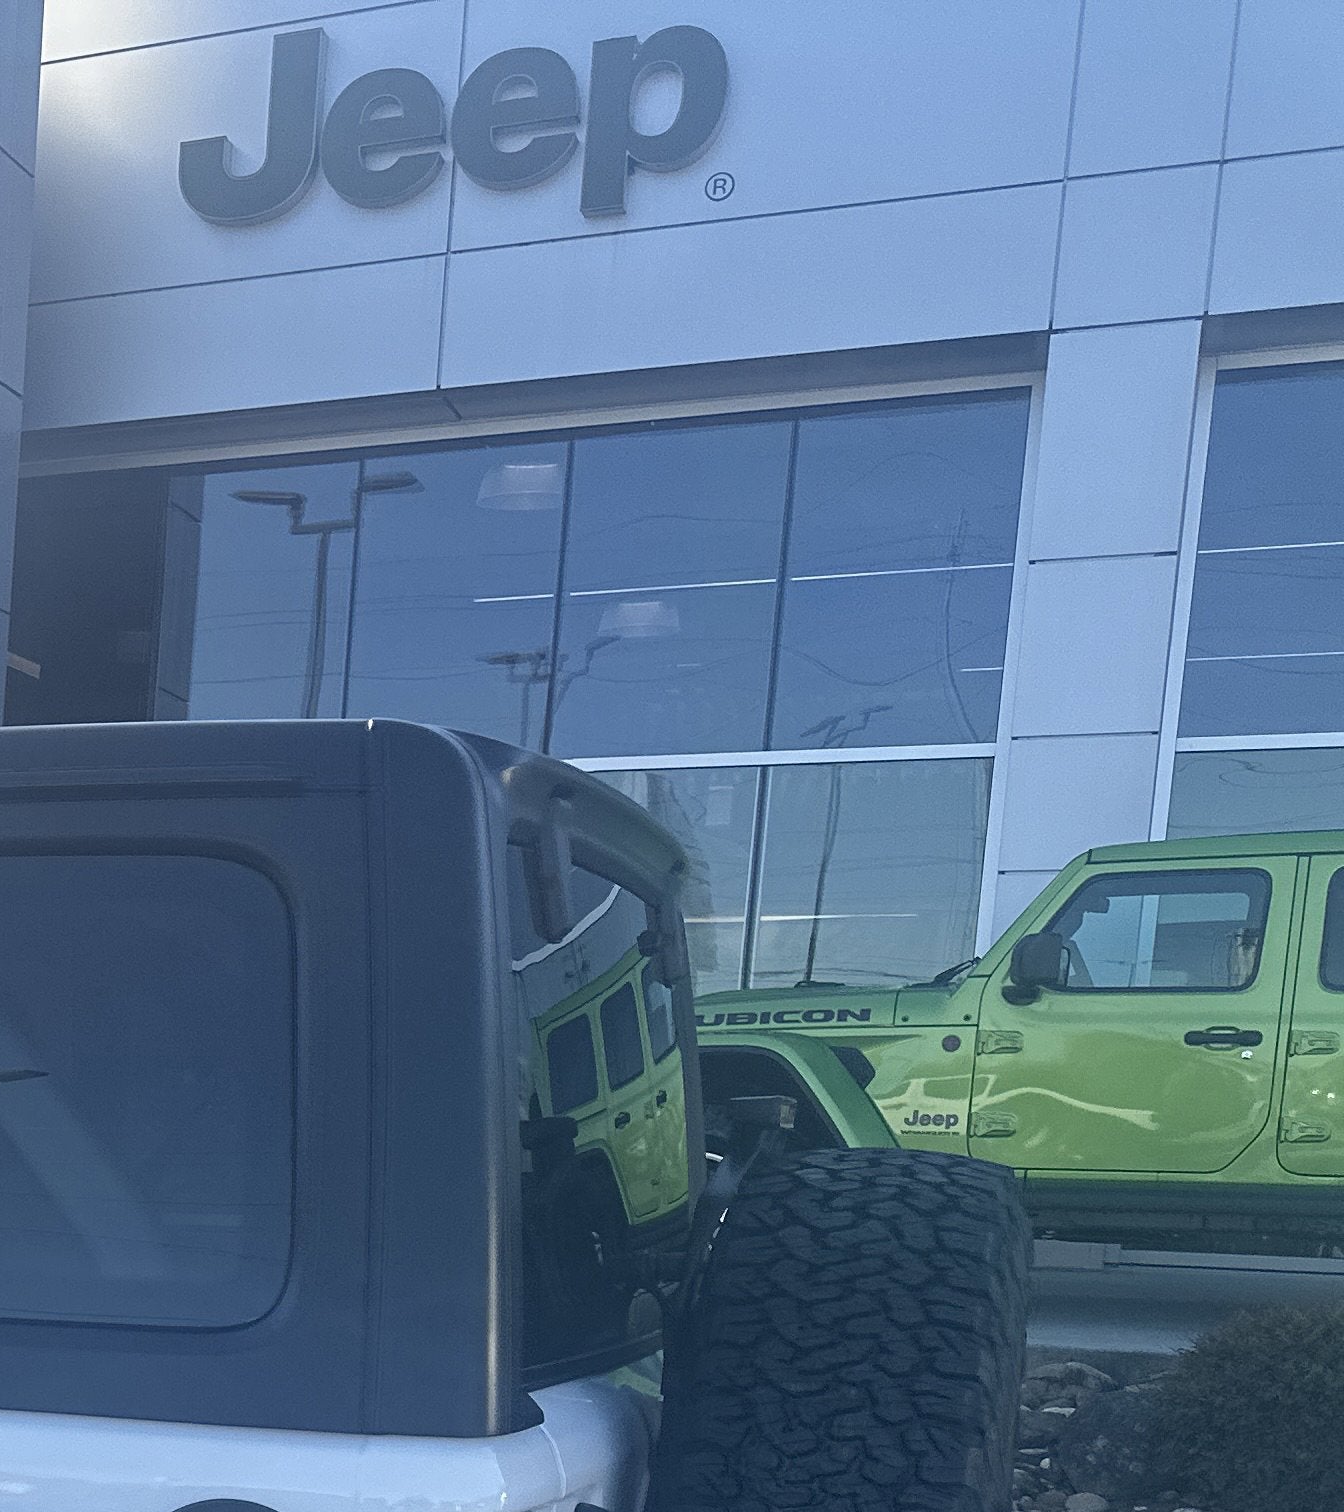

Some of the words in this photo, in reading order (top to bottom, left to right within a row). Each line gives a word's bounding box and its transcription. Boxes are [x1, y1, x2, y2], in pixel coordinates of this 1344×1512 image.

[178, 25, 730, 226] Jeep
[696, 1008, 872, 1027] UBICON
[904, 1110, 959, 1129] Jeep
